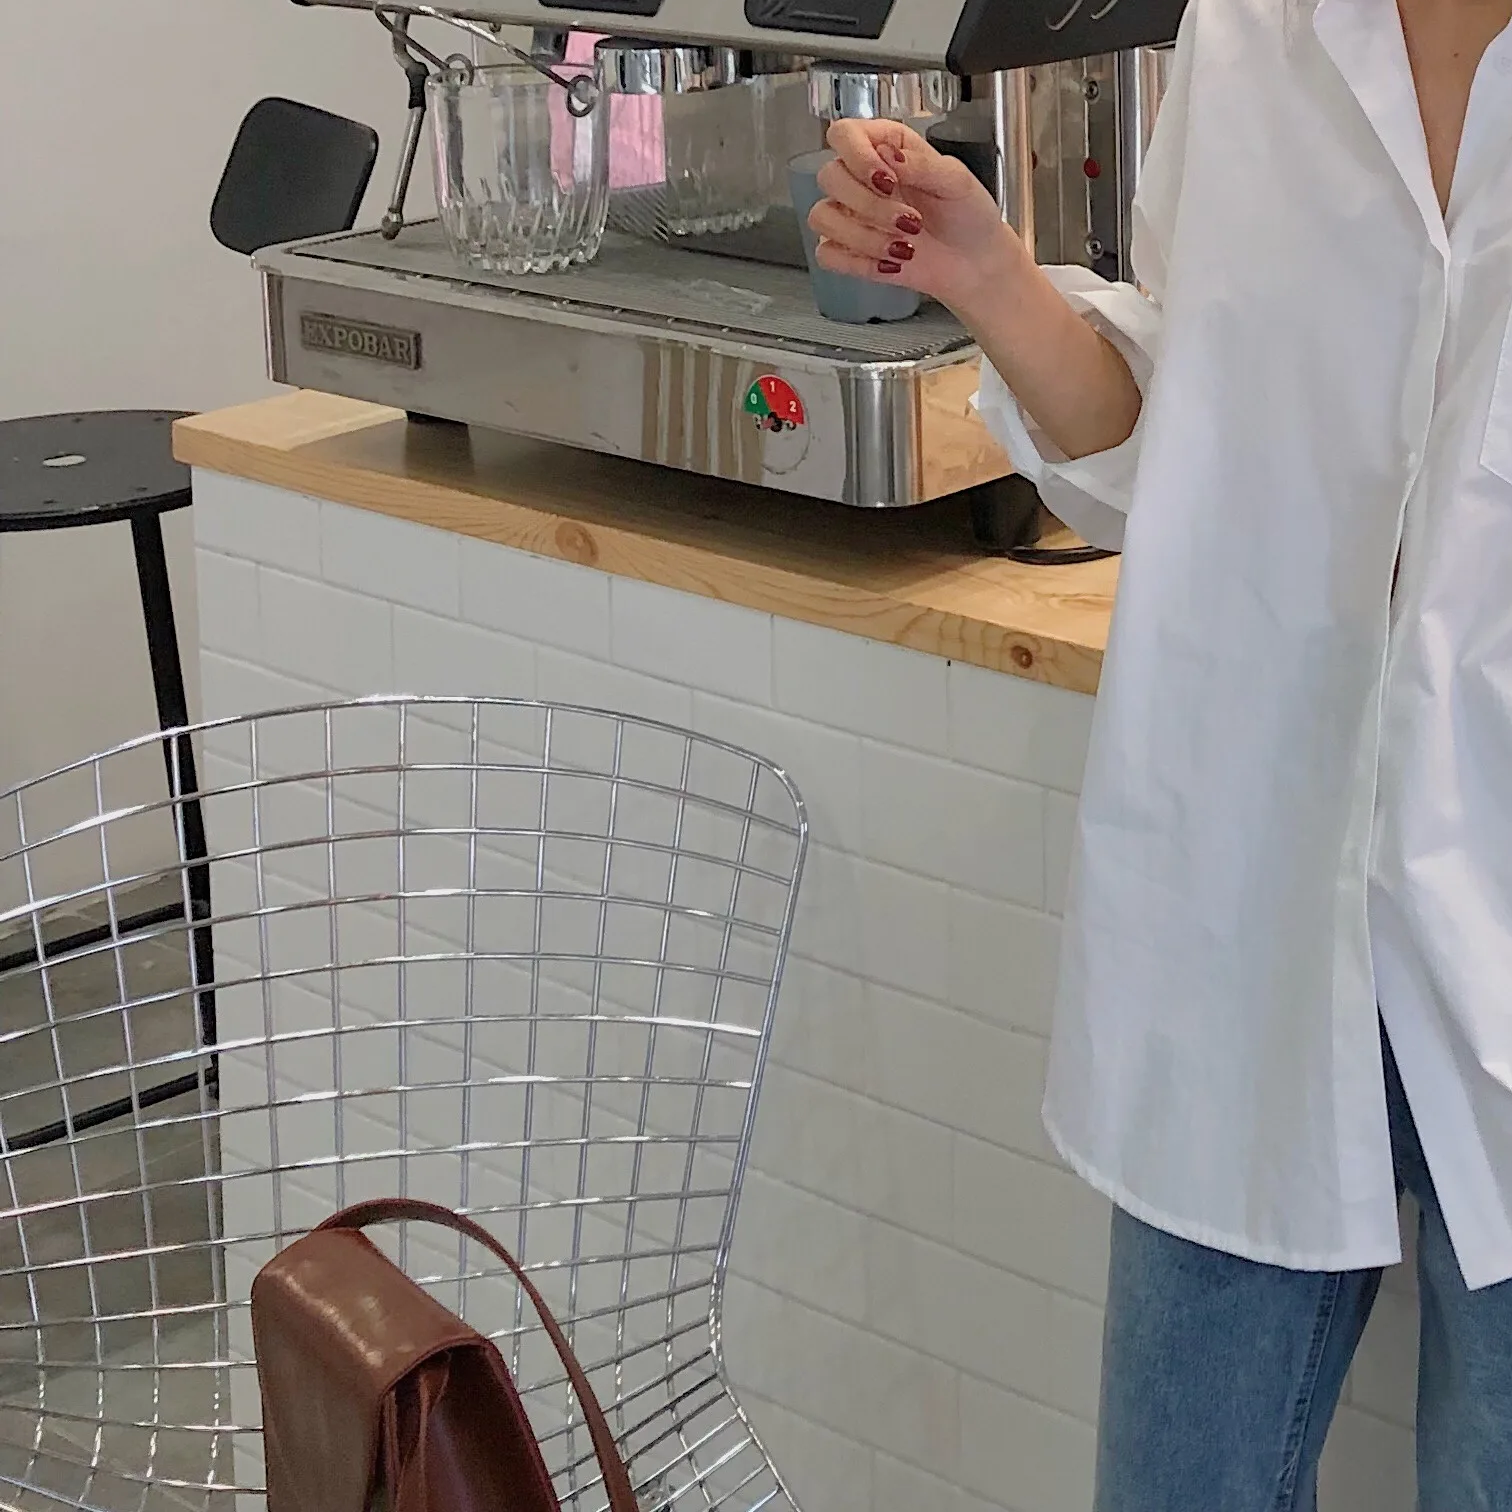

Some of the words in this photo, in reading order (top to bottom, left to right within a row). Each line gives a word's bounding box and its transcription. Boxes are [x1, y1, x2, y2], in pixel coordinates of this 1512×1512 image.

[303, 320, 411, 362] EXPOBAR
[750, 393, 758, 405] 0
[769, 380, 776, 393] 1
[789, 400, 797, 413] 2
